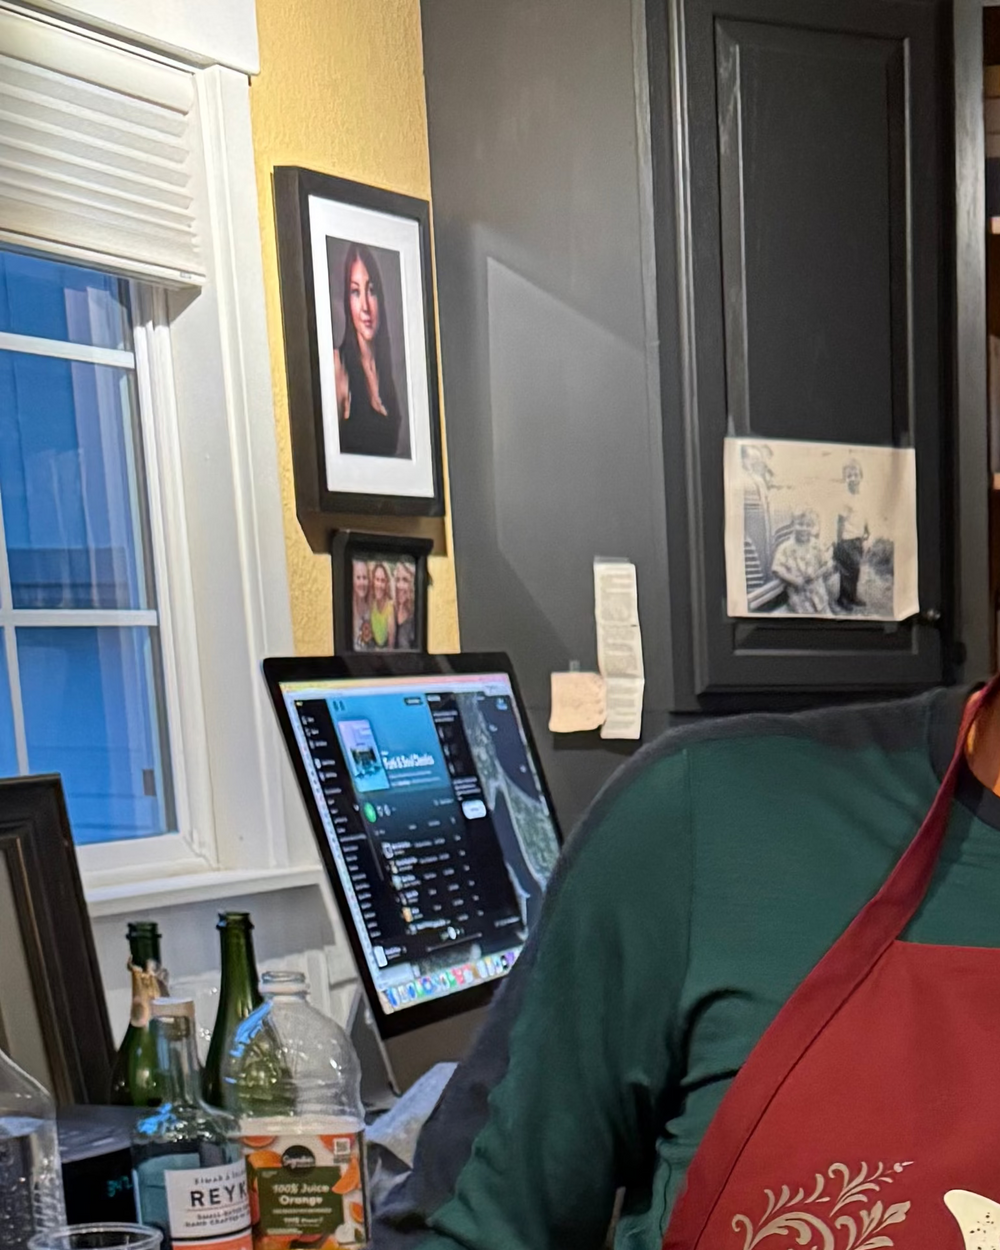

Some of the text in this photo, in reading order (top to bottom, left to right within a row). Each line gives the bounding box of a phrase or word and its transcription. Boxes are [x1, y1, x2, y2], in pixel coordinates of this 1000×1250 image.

[272, 1183, 330, 1195] 100% Juice
[278, 1194, 323, 1207] Orange
